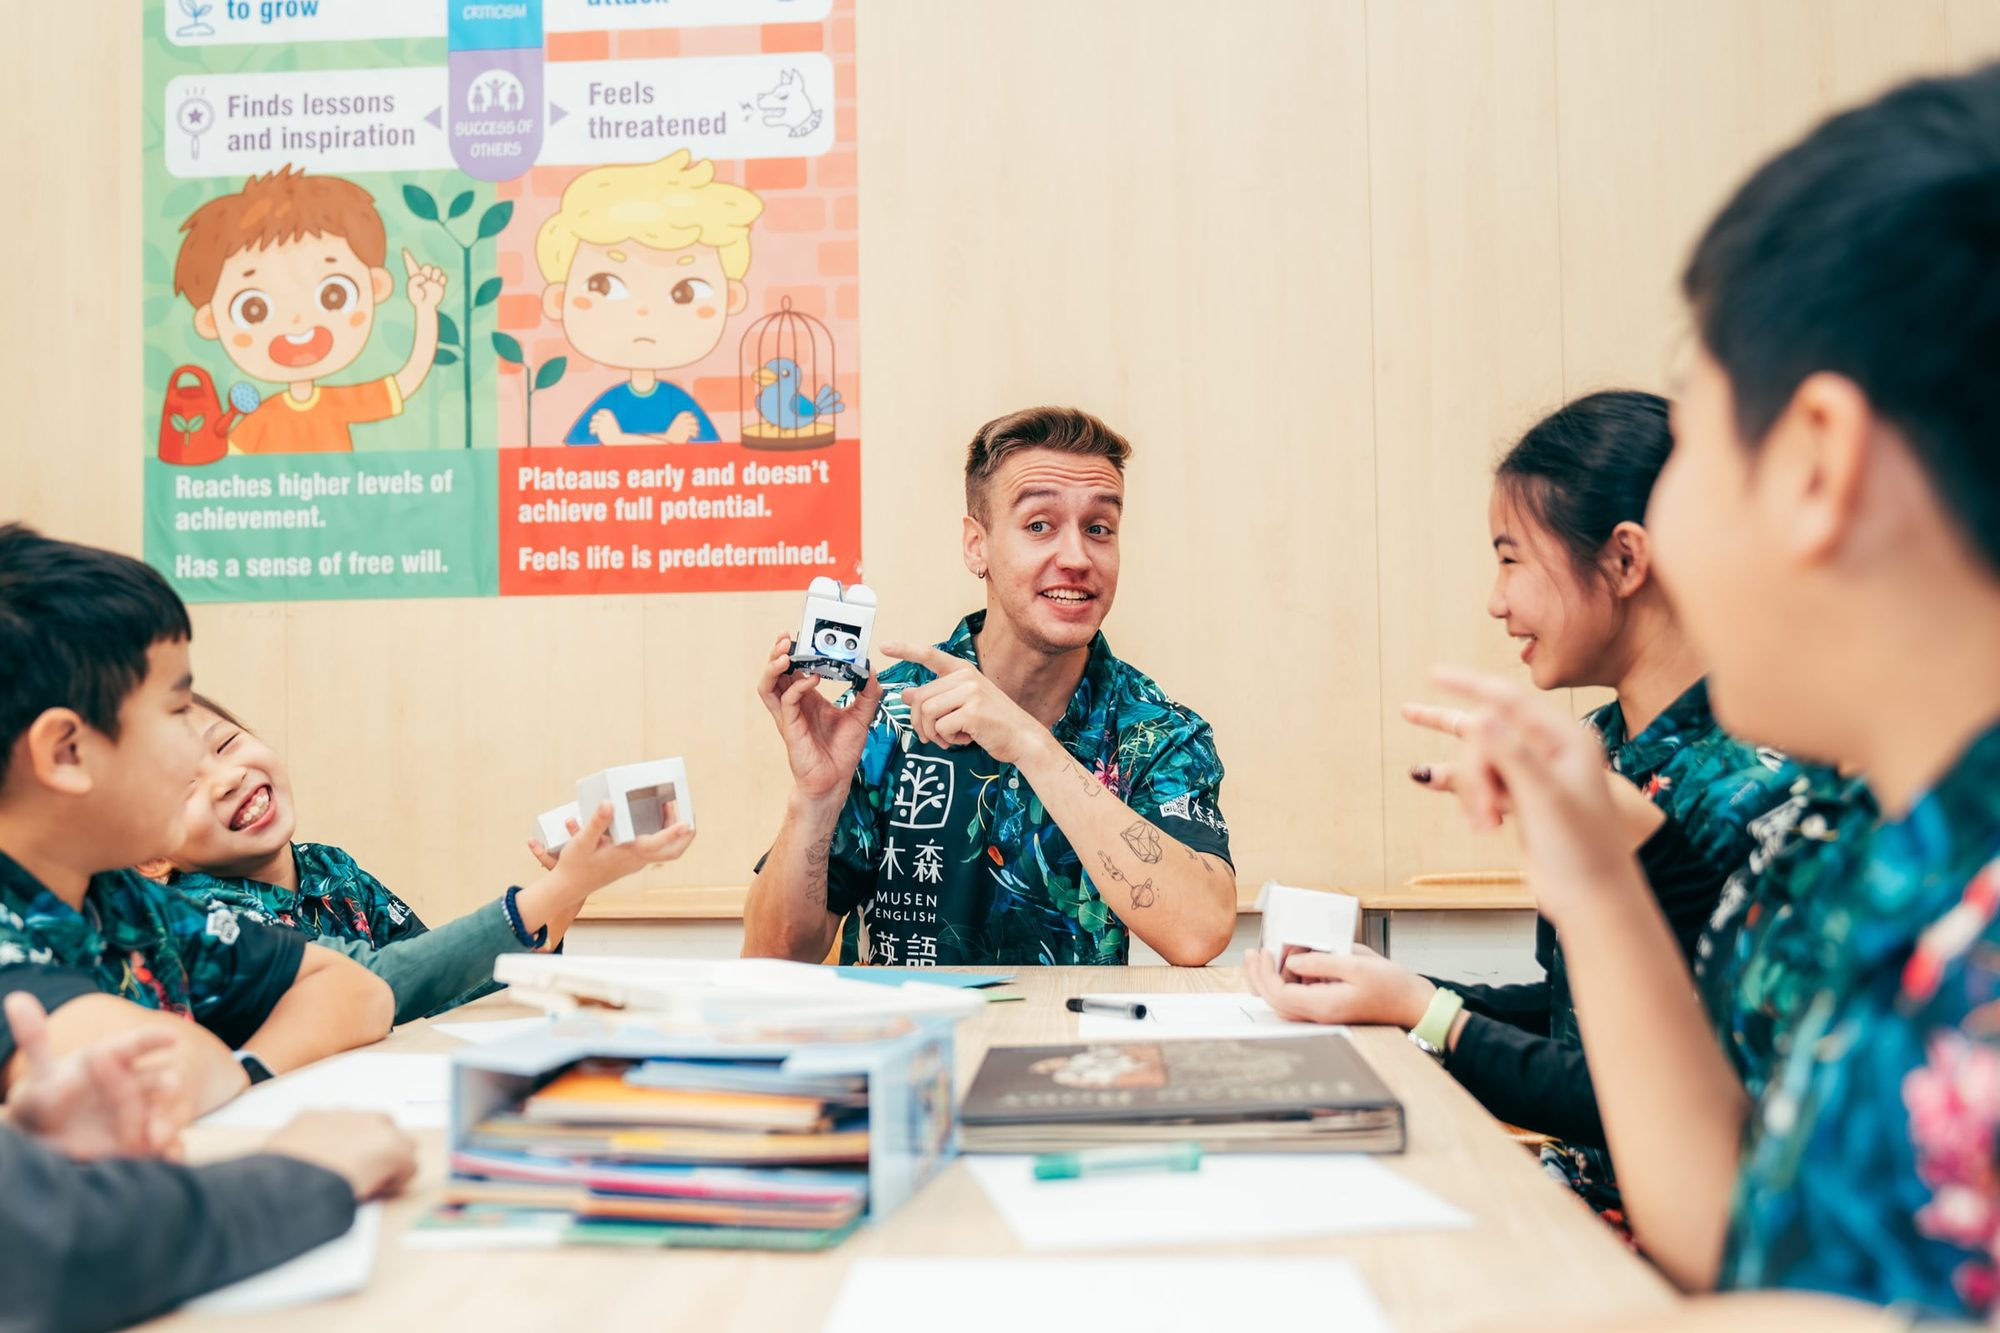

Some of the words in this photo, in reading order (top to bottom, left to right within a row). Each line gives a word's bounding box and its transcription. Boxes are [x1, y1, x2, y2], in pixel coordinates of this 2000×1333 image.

[228, 0, 250, 20] to
[261, 0, 319, 24] grow
[462, 4, 527, 20] CRITICISM
[589, 82, 654, 104] Feels
[228, 94, 293, 118] Finds
[303, 93, 395, 115] lessons
[455, 121, 515, 136] SUCCESS
[517, 119, 533, 134] OF
[589, 112, 726, 138] threatened
[228, 129, 271, 151] and
[282, 125, 415, 153] inspiration
[470, 141, 521, 158] OTHERS
[175, 475, 272, 499] Reaches
[279, 473, 351, 500] higher
[358, 471, 423, 494] levels
[430, 469, 453, 493] of
[518, 466, 620, 491] Plateaus
[627, 463, 685, 491] early
[692, 462, 735, 487] and
[742, 460, 829, 486] doesn’t
[175, 506, 326, 530] achievement.
[518, 498, 607, 523] achieve
[614, 496, 653, 521] full
[660, 494, 772, 525] potential.
[175, 555, 219, 578] Has
[225, 558, 240, 577] a
[246, 556, 312, 577] sense
[318, 552, 342, 575] of
[348, 551, 394, 574] free
[402, 549, 449, 573] will.
[518, 546, 580, 571] Feels
[586, 545, 625, 570] life
[631, 544, 652, 568] is
[658, 540, 837, 573] predetermined.
[876, 891, 938, 907] MUSEN
[875, 907, 937, 923] ENGLISH
